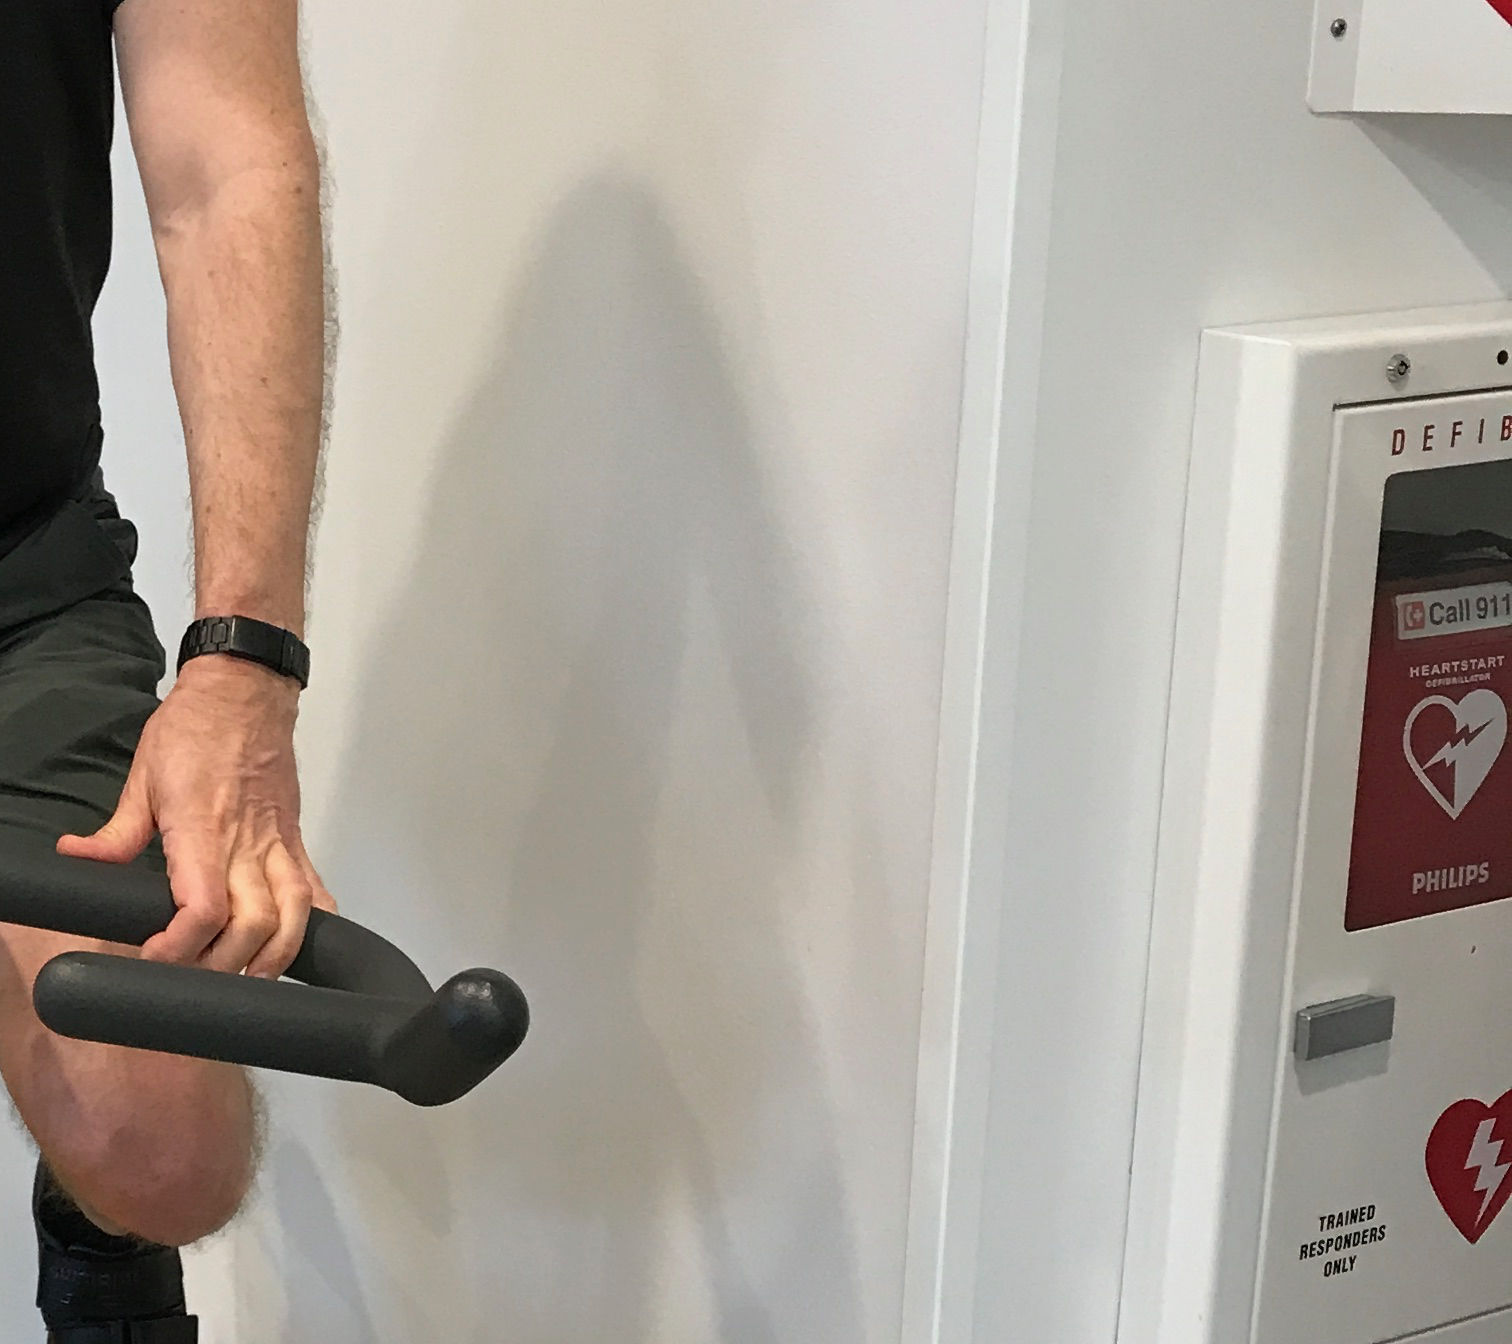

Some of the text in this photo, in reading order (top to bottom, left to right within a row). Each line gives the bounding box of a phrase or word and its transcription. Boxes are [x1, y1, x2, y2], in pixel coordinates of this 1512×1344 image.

[1429, 593, 1510, 626] Call 911
[1409, 655, 1505, 678] HEARTSTART
[1412, 861, 1489, 895] PHILIPS
[1318, 1204, 1376, 1232] TRAINED
[1299, 1224, 1386, 1261] RESPONDERS
[1323, 1254, 1357, 1278] ONLY
